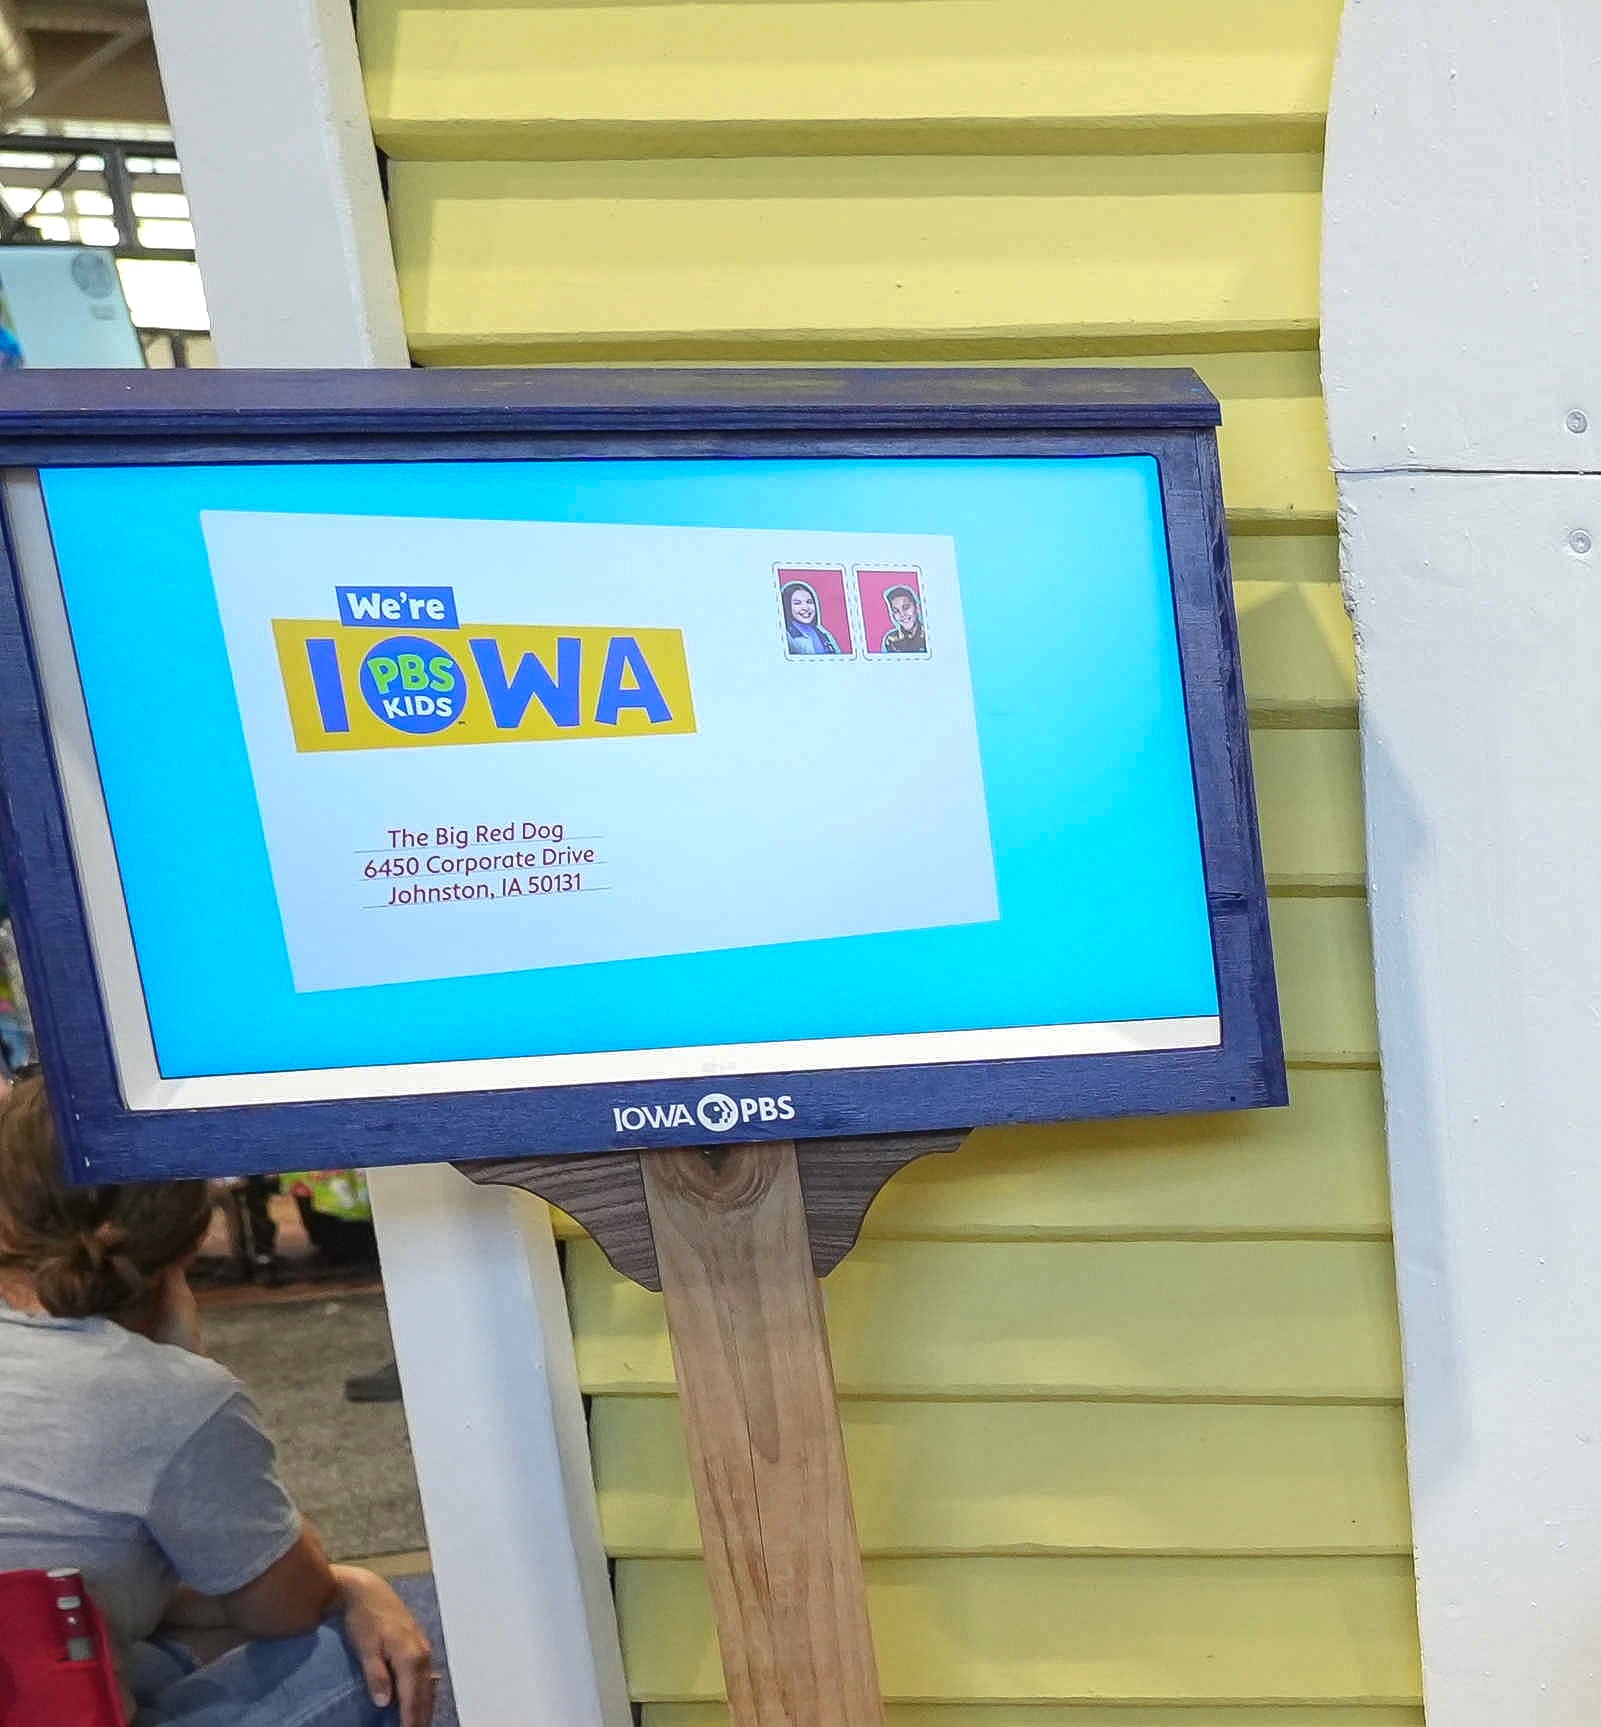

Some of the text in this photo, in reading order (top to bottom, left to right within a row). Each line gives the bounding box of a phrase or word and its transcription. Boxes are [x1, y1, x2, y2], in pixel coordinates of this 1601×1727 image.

[345, 591, 445, 620] We're
[367, 653, 456, 694] PBS
[382, 695, 453, 719] KIDS
[388, 822, 563, 849] The Big Red Dog
[364, 846, 594, 878] 6450 Corporate Drive
[388, 873, 582, 905] Johnston, IA 50131
[613, 1095, 795, 1132] IOWA PBS
